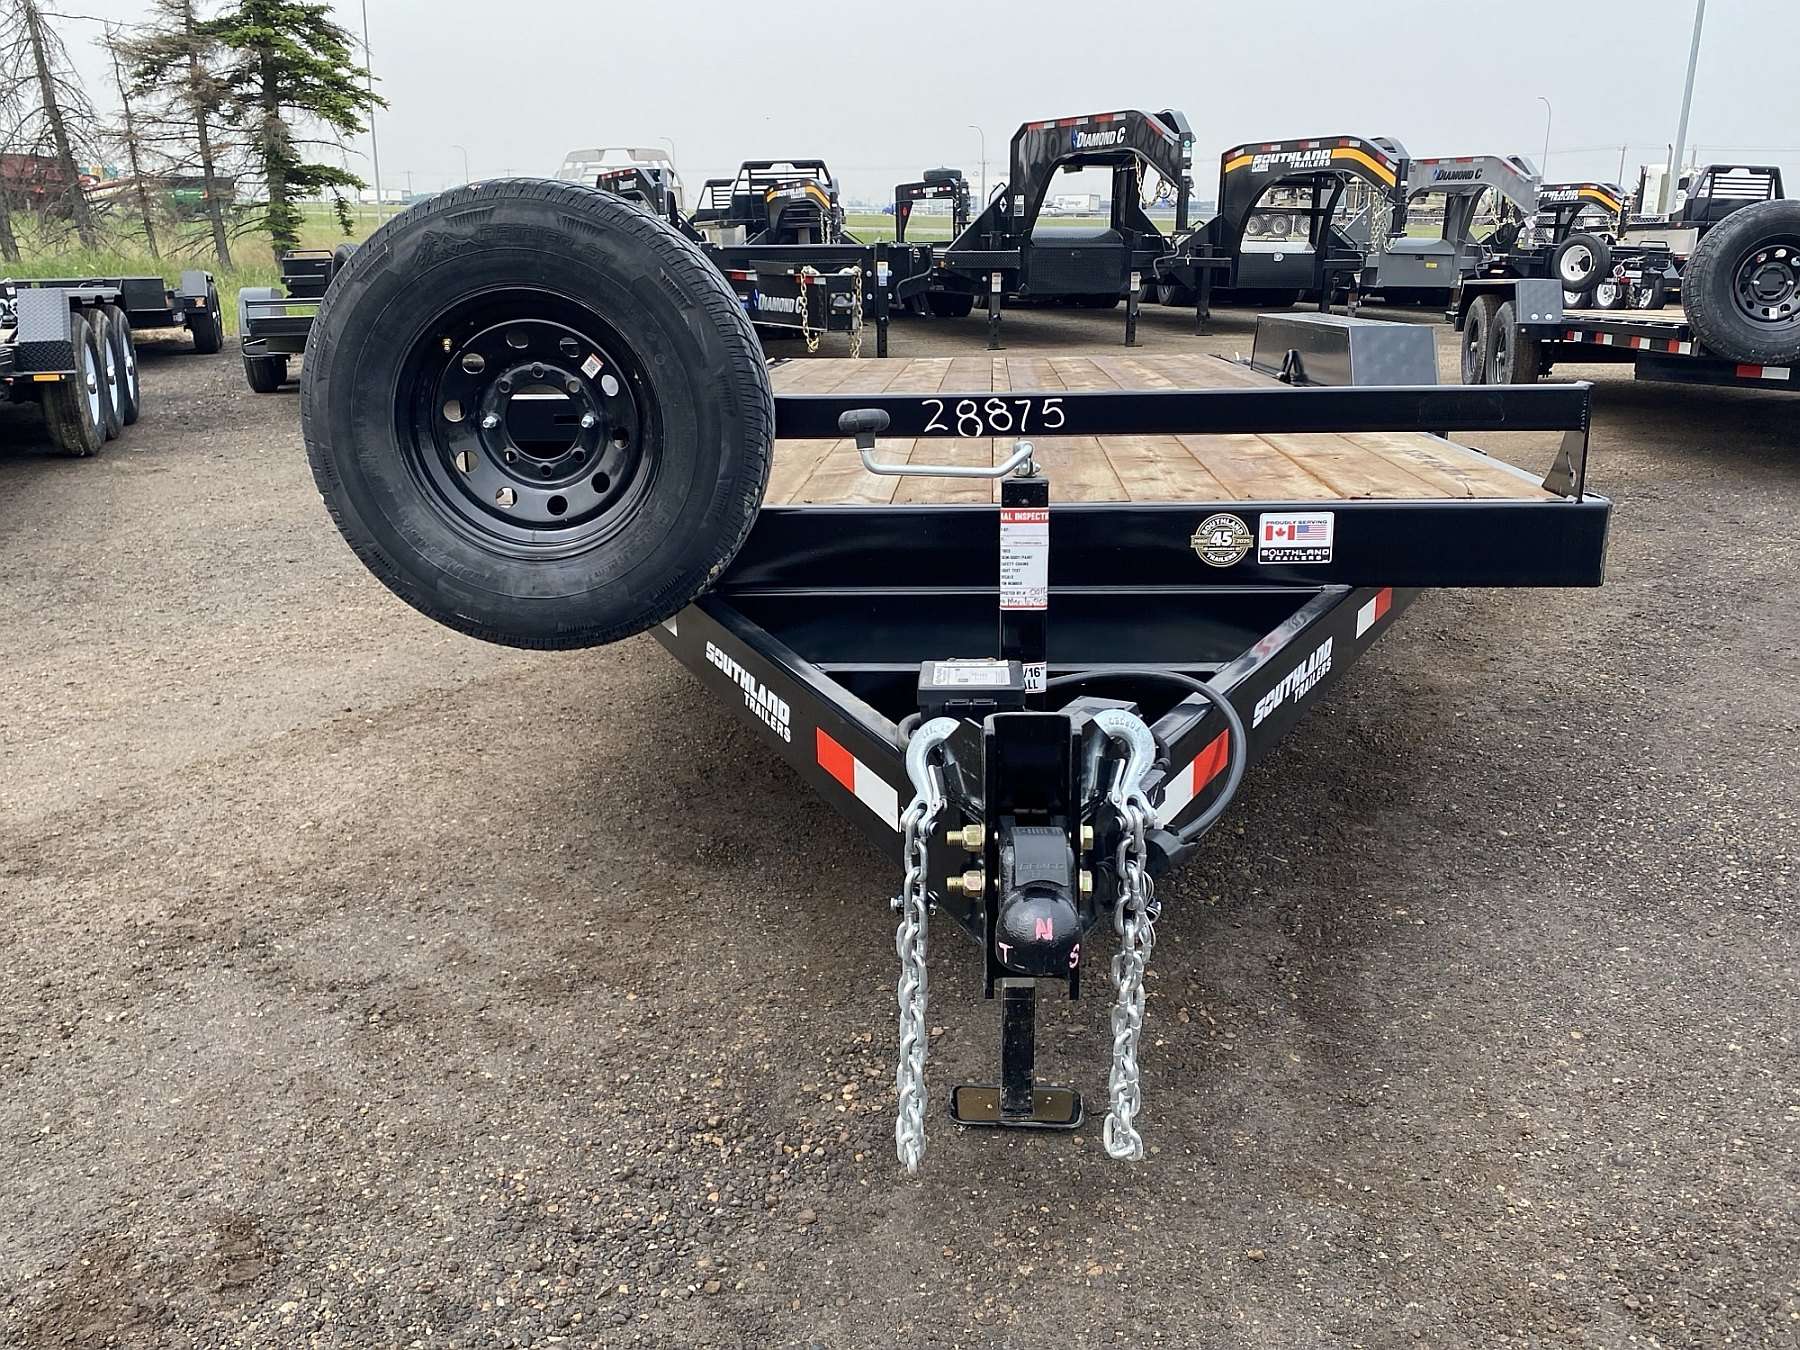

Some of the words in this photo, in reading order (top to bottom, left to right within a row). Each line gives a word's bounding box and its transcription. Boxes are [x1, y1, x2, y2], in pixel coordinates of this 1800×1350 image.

[1076, 131, 1116, 148] DIAMOND
[1116, 127, 1126, 144] C
[1253, 149, 1332, 164] SOUTHLAND
[1290, 159, 1331, 169] TRAILERS
[1437, 169, 1474, 181] DIAMOND
[1474, 167, 1483, 180] C
[758, 294, 795, 313] DIAMOND
[922, 398, 1065, 437] 28875
[1202, 518, 1244, 536] SOUTHLAND
[1210, 531, 1233, 547] 45
[1207, 552, 1238, 562] TRAILERS
[1261, 548, 1330, 558] SOUTHLAND
[705, 640, 791, 727] SOUTHLAND
[1252, 636, 1333, 729] SOUTHLAND
[1293, 656, 1332, 704] TRAILERS
[743, 691, 792, 743] TRAILERS
[1035, 917, 1054, 941] N
[998, 941, 1014, 964] T
